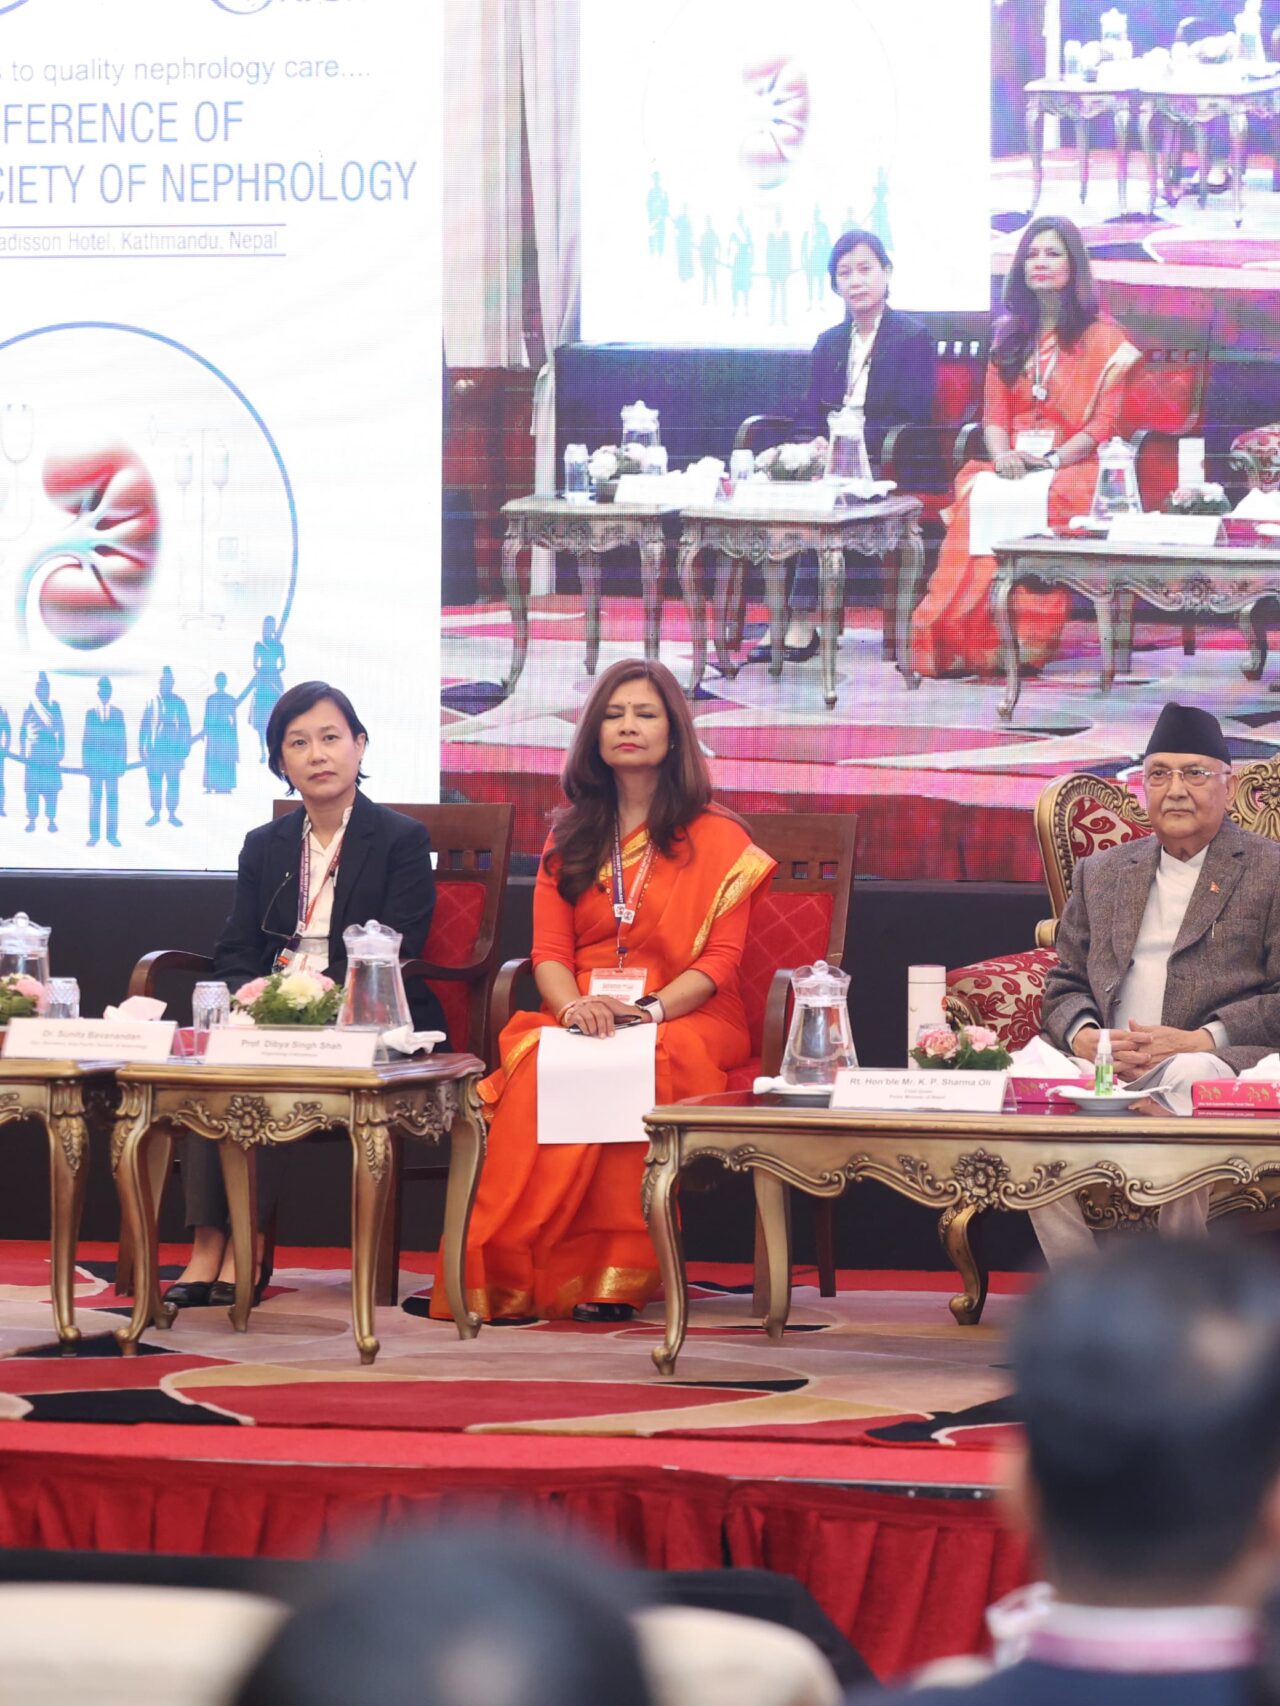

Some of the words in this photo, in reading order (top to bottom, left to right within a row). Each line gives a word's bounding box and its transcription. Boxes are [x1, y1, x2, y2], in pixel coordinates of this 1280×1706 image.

[12, 60, 34, 82] to
[43, 58, 125, 87] quality
[134, 55, 275, 84] nephrology
[195, 101, 244, 143] OF
[0, 163, 85, 205] IETY
[100, 163, 147, 204] OF
[162, 160, 417, 203] NEPHROLOGY
[230, 230, 278, 254] Nepal
[942, 1078, 976, 1087] Sharma
[978, 1078, 991, 1087] Oli
